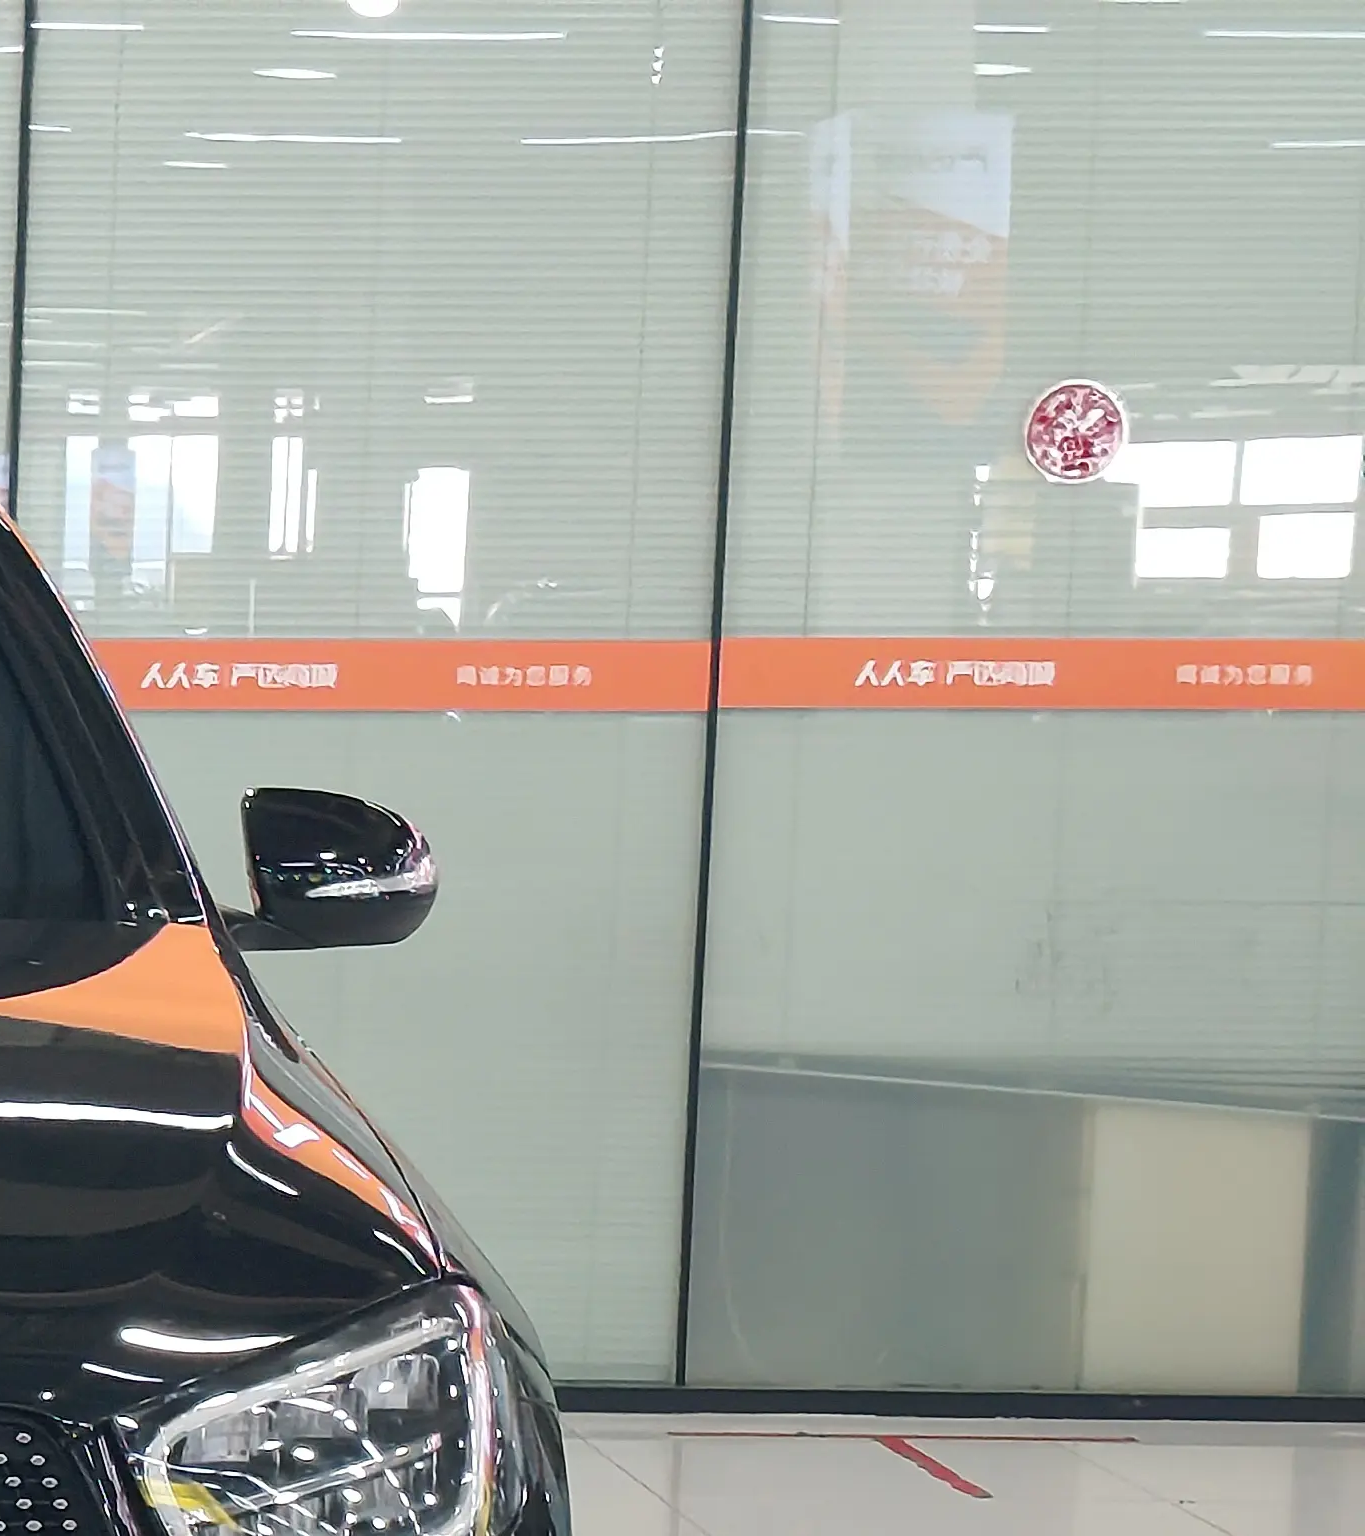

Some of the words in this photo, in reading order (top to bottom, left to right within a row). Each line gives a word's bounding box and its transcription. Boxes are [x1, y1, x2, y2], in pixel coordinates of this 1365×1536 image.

[140, 661, 221, 689] 人人车
[854, 659, 938, 687] 人人车
